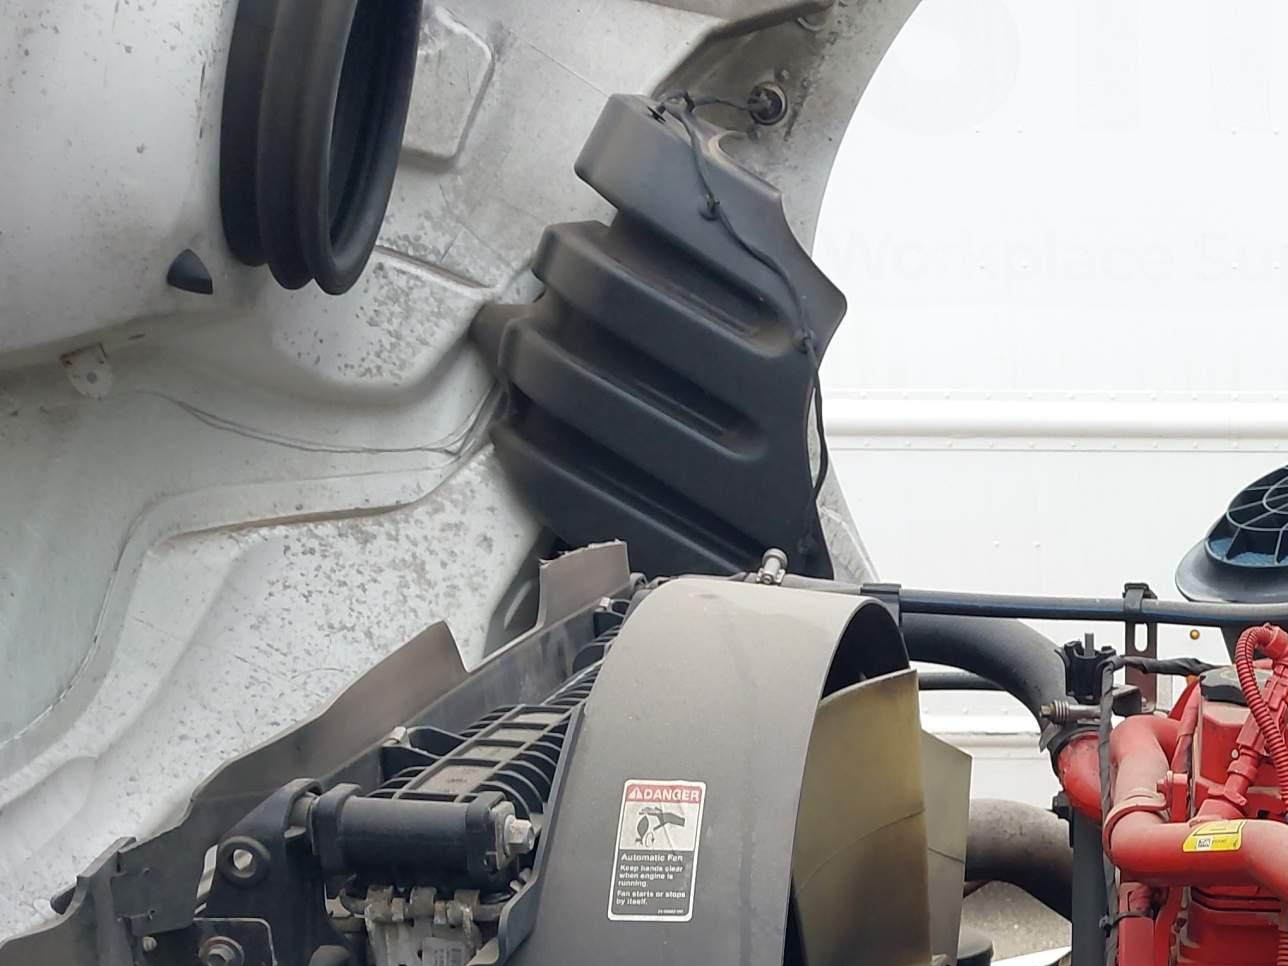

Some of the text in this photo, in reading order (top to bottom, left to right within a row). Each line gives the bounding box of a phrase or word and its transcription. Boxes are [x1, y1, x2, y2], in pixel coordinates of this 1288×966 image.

[643, 789, 700, 802] DANGER
[620, 853, 684, 862] Automatic Fan
[620, 864, 639, 873] Keep
[640, 864, 663, 872] hands
[619, 872, 639, 880] when
[640, 873, 665, 881] engine
[617, 889, 631, 897] Fan
[632, 890, 654, 898] starts
[665, 890, 686, 899] stops
[616, 898, 625, 906] by
